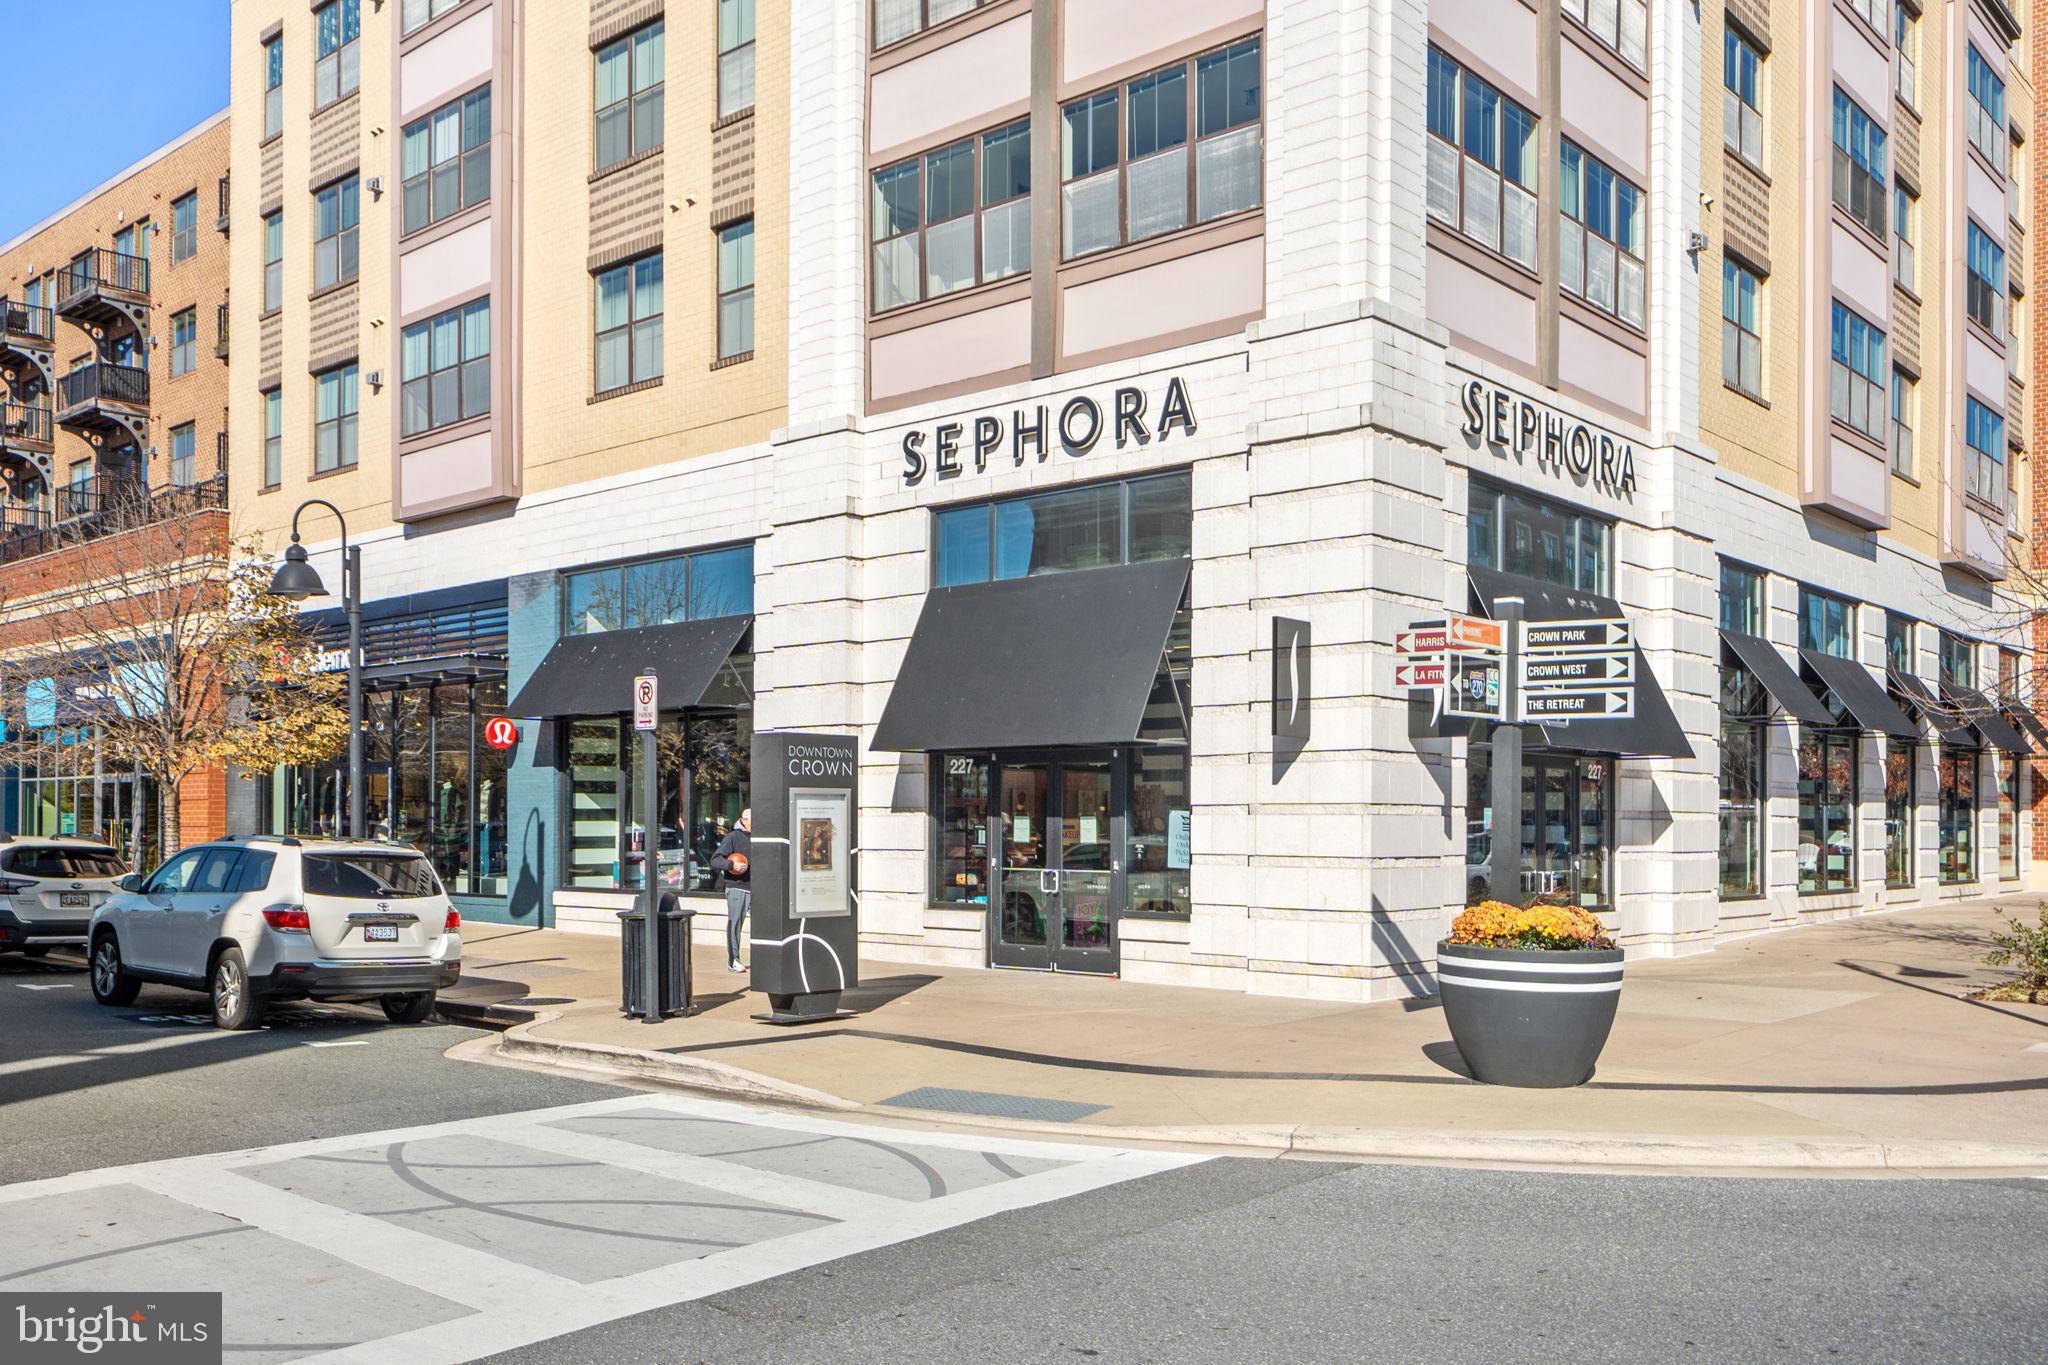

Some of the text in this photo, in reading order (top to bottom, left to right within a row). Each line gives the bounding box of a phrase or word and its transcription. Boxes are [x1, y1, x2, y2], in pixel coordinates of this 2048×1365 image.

[902, 376, 1197, 482] SEPHORA
[1461, 380, 1637, 493] SEPHORA
[1415, 636, 1445, 647] HARRIS
[1528, 630, 1586, 643] CROWN PARK
[1415, 671, 1425, 680] LA
[1527, 664, 1587, 677] CROWN WEST
[1472, 680, 1484, 695] 270
[1527, 699, 1586, 710] THE RETREAT
[788, 745, 853, 759] DOWNTOWN
[788, 758, 853, 777] CROWN
[950, 758, 974, 775] 227
[1587, 764, 1602, 780] 227
